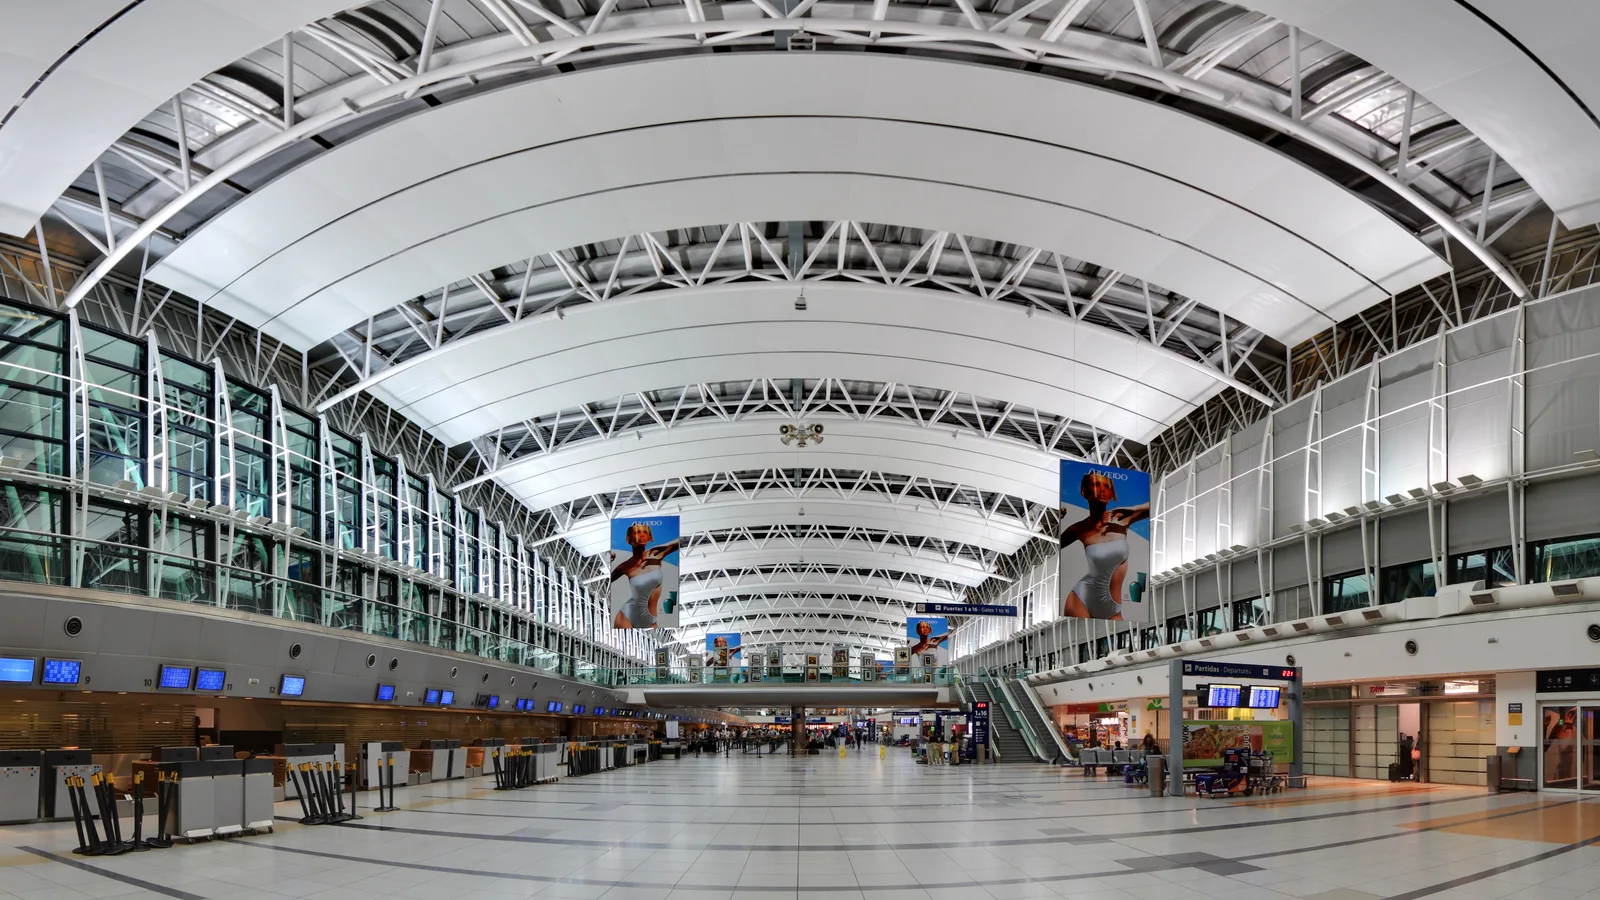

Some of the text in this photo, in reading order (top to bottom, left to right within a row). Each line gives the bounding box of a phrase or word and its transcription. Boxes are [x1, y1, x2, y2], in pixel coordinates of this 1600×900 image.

[1194, 664, 1251, 675] Partidas Departures
[84, 676, 91, 685] 9
[143, 679, 153, 687] 10
[226, 683, 233, 691] 11
[269, 686, 276, 694] 12
[1369, 685, 1386, 693] TAM
